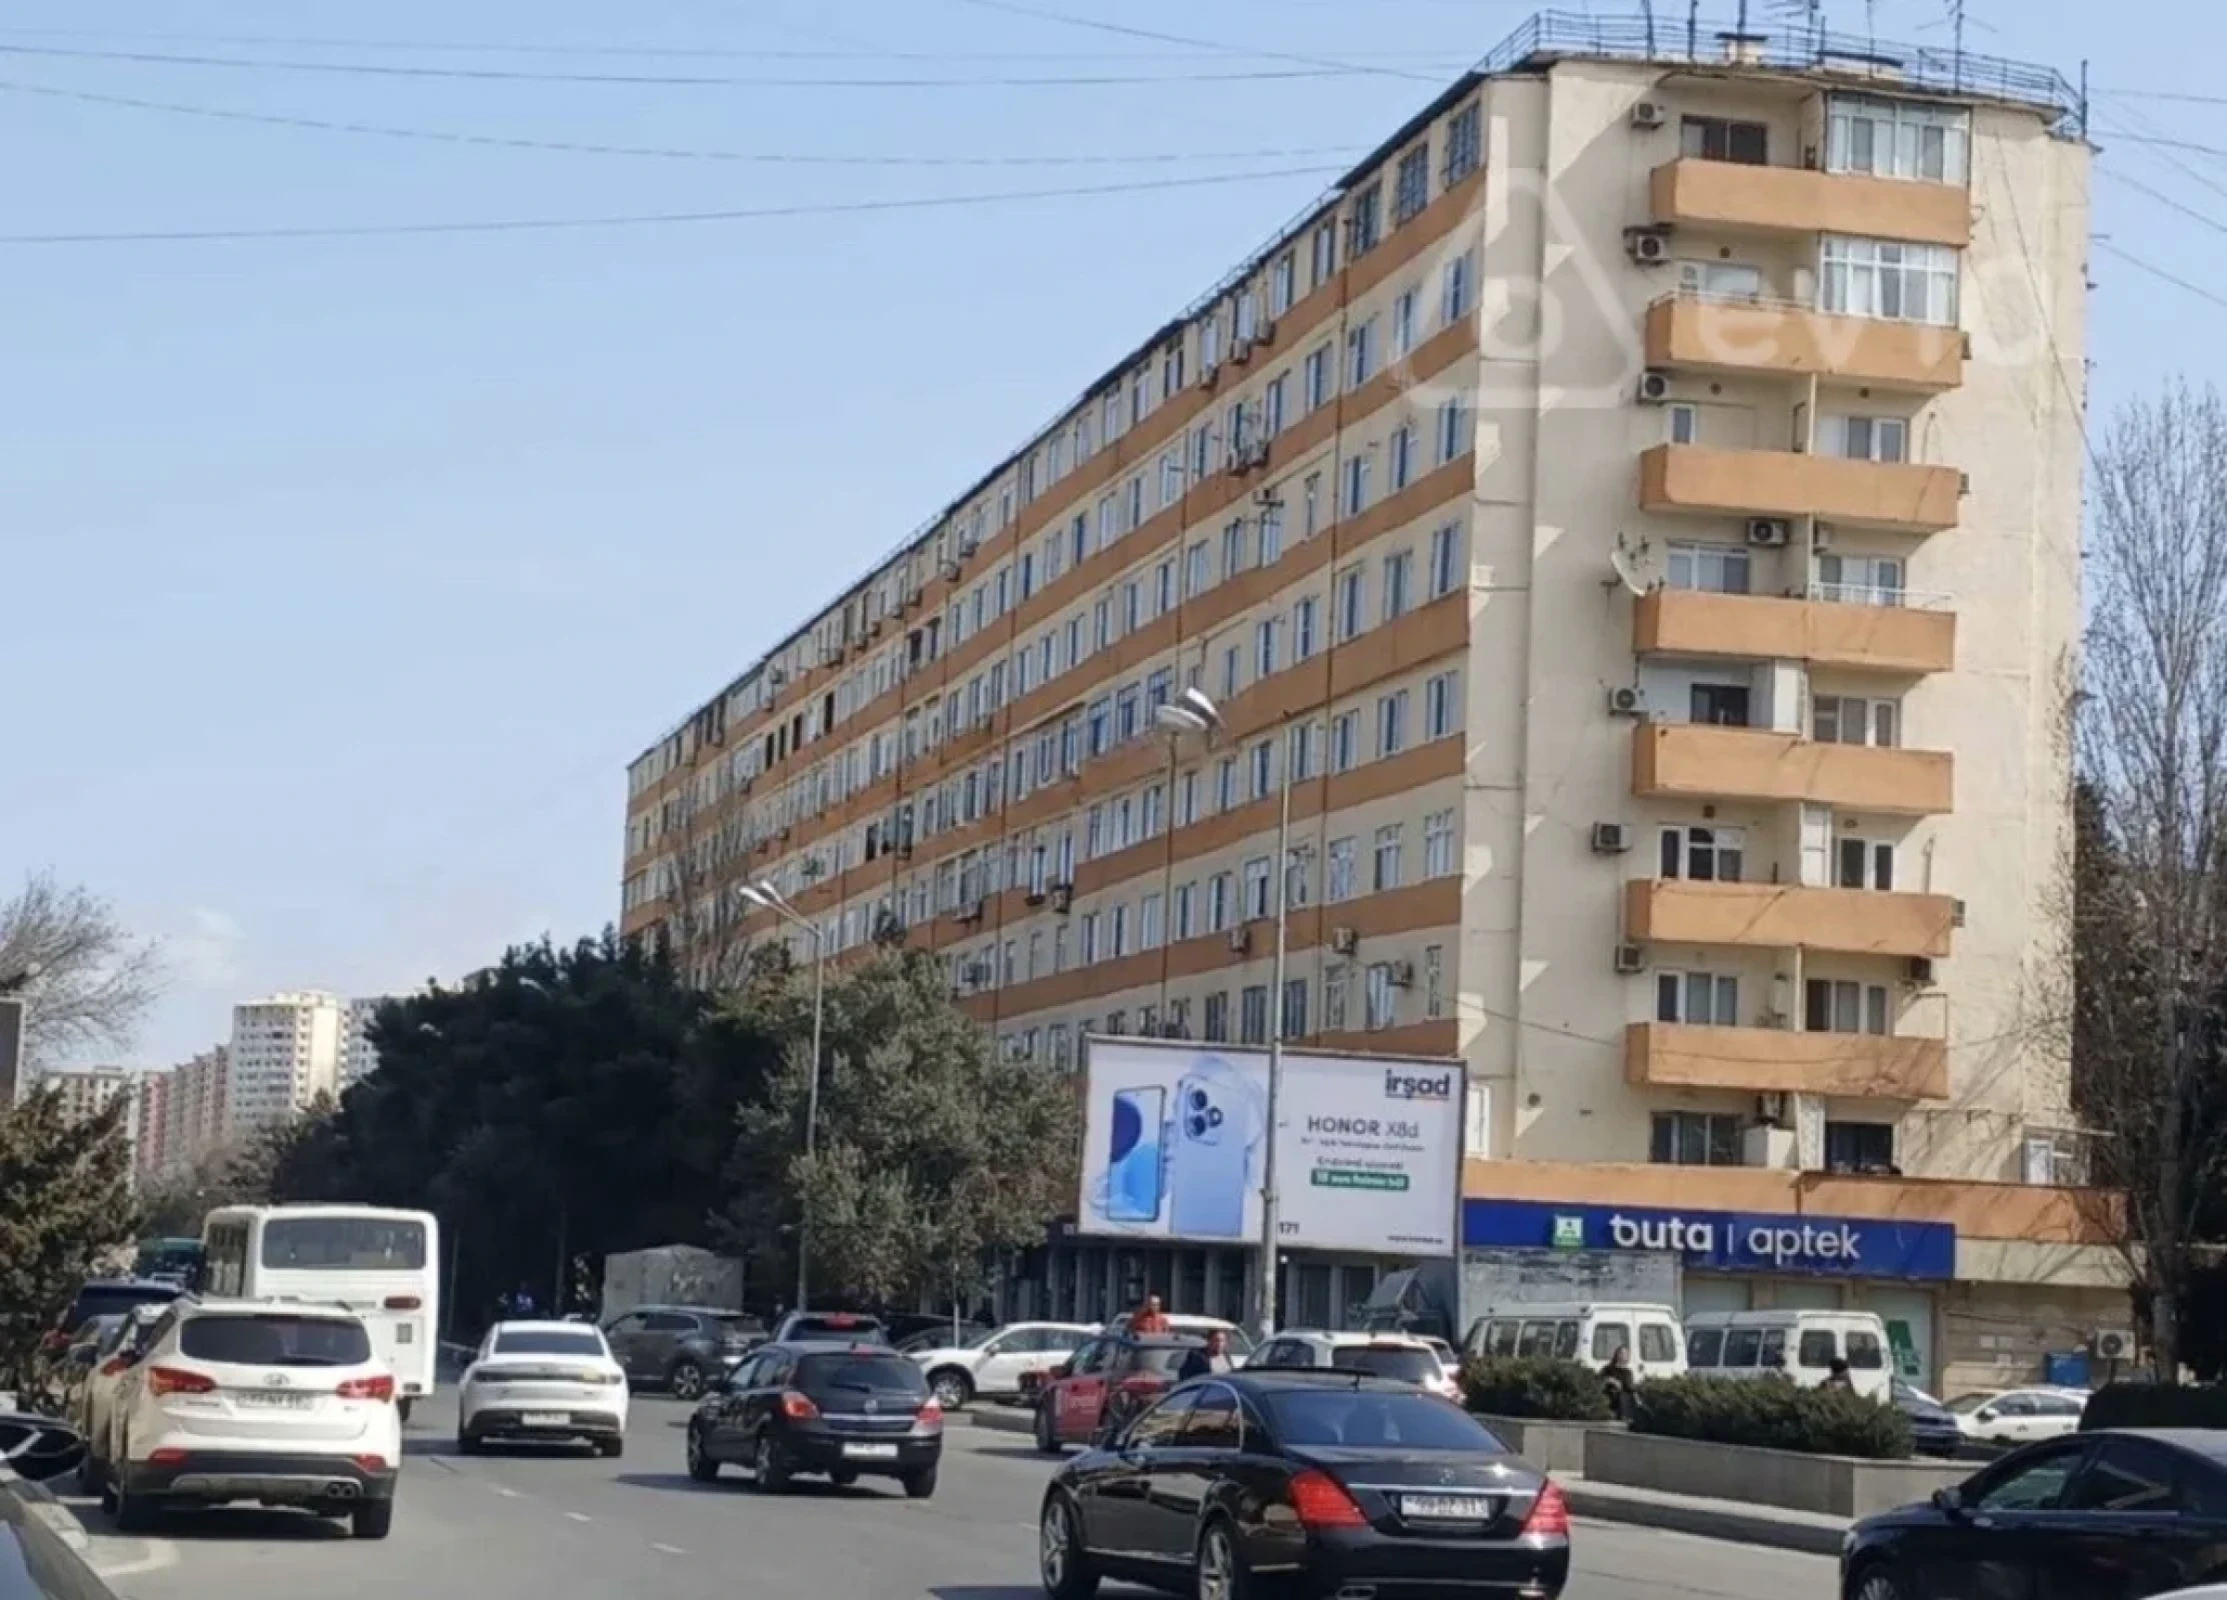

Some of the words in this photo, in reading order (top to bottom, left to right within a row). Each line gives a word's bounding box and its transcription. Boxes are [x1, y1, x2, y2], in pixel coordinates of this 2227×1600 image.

[1307, 1115, 1381, 1137] HONOR
[1609, 1213, 1714, 1251] buta
[1749, 1224, 1862, 1265] aptek
